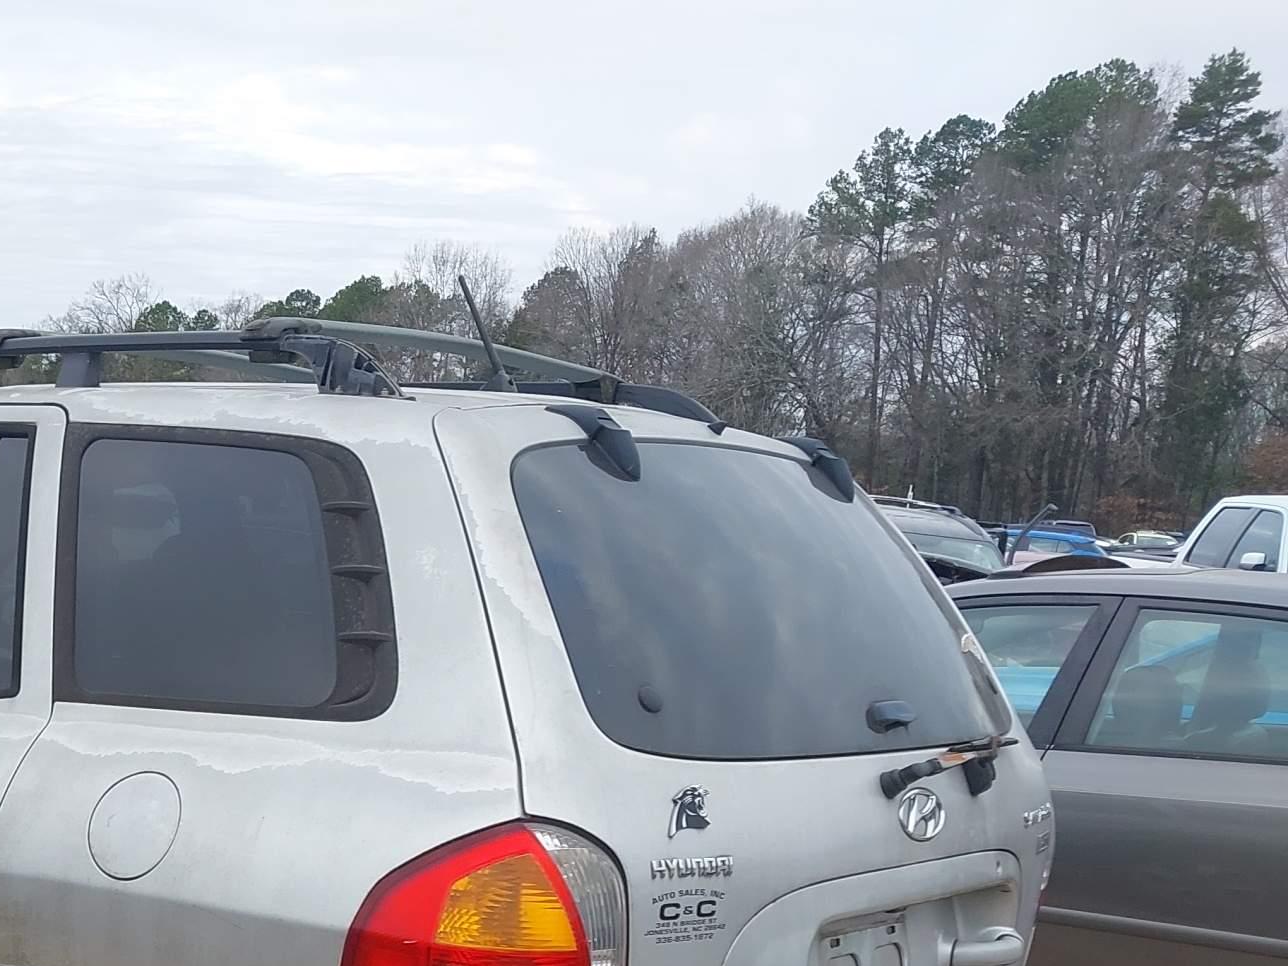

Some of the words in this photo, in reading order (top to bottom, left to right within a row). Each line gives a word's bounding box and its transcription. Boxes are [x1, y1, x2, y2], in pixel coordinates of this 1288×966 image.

[650, 856, 734, 880] HYUNDAI
[651, 891, 676, 905] AUTO
[659, 902, 681, 921] C
[682, 905, 694, 915] &
[696, 899, 717, 918] C
